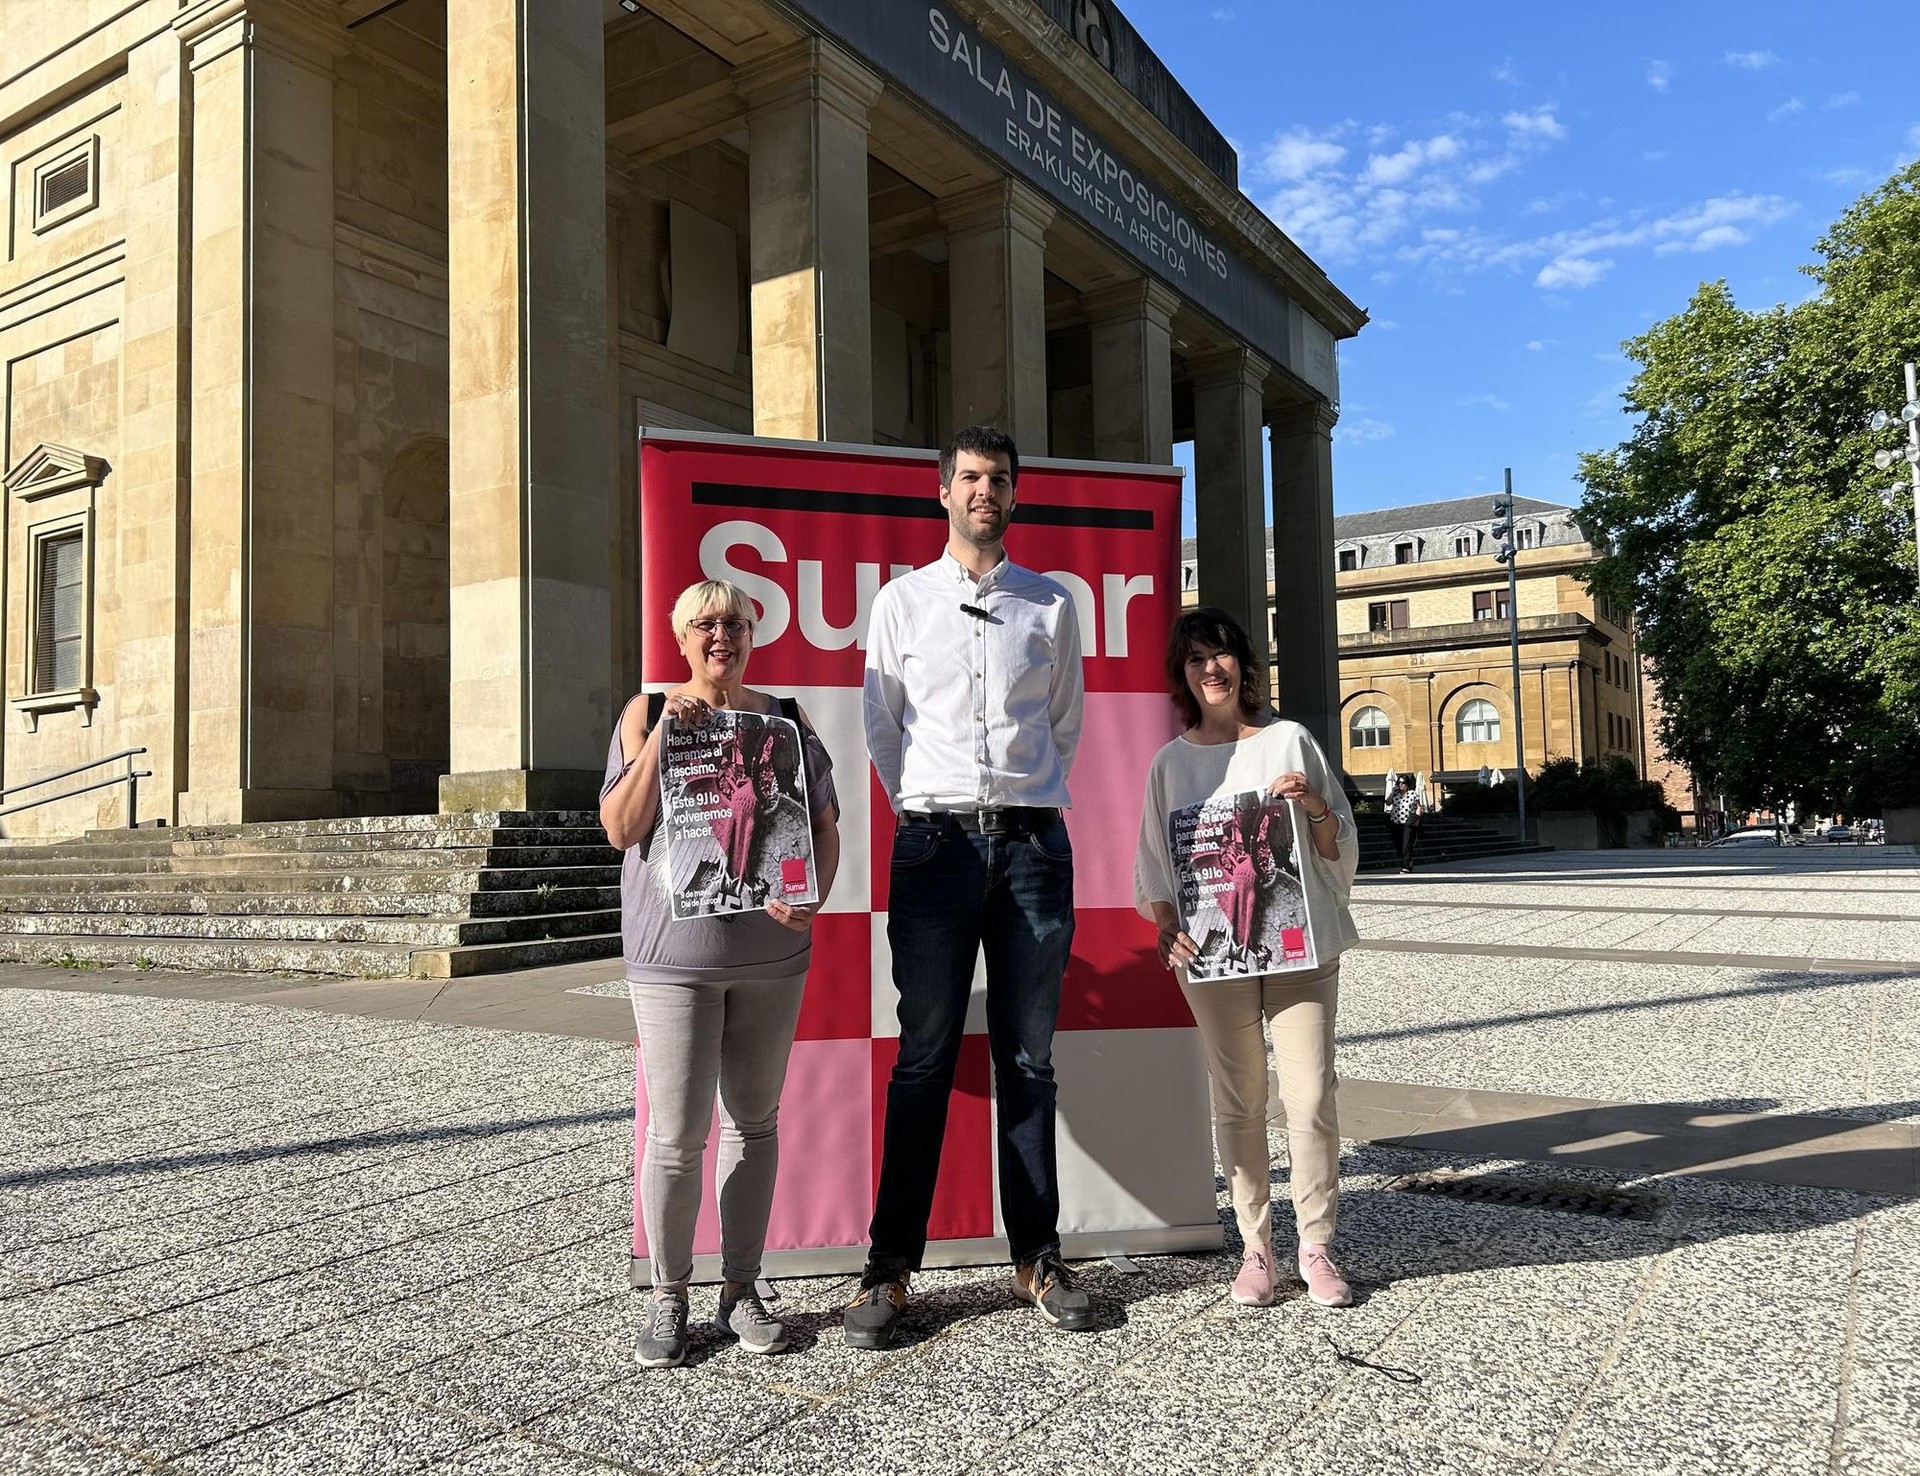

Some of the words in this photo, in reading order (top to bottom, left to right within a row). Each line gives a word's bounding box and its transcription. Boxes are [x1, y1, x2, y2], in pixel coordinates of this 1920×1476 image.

[928, 8, 1016, 111] SALA
[1025, 88, 1062, 148] DE
[1071, 126, 1228, 280] EXPOSICIONES
[1006, 118, 1125, 231] ERAKUSKETA
[1128, 218, 1187, 277] ARETOA
[699, 520, 1155, 658] Sur
[666, 733, 693, 747] Hace
[693, 730, 708, 744] 79
[667, 749, 712, 766] paramos
[713, 742, 723, 757] al
[668, 763, 718, 778] fascismo.
[672, 795, 695, 809] Este
[709, 791, 720, 805] lo
[673, 808, 733, 825] volveremos
[1174, 817, 1197, 829] Hace
[1198, 811, 1210, 825] 79
[675, 830, 681, 840] a
[1175, 827, 1215, 844] paramos
[1214, 822, 1224, 836] al
[1176, 840, 1220, 855] fascismo.
[1181, 869, 1201, 883] Este
[784, 883, 806, 892] Sumar
[1183, 881, 1235, 897] volveremos
[1185, 901, 1191, 911] a
